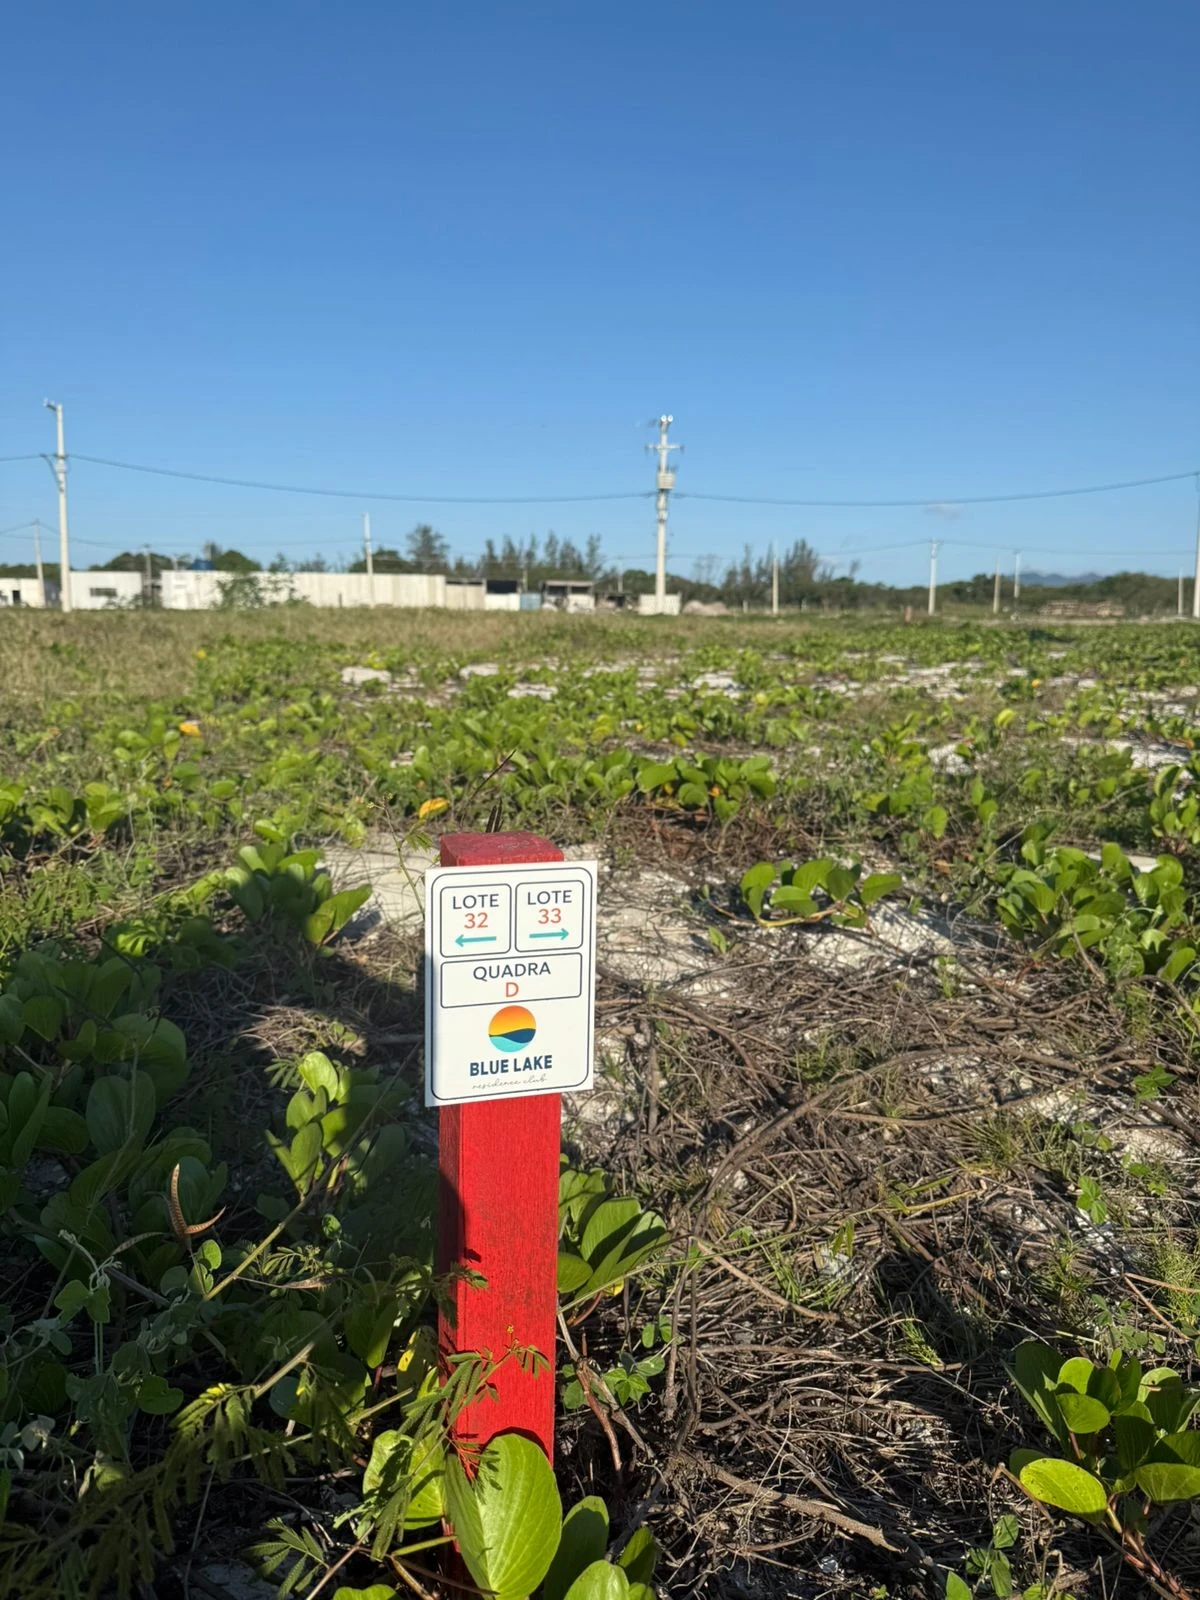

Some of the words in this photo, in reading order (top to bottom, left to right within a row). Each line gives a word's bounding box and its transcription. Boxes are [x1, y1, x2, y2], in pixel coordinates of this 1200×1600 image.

[452, 893, 500, 910] LOTE
[527, 890, 573, 906] LOTE
[464, 912, 489, 929] 32
[538, 908, 562, 925] 33
[473, 961, 551, 982] QUADRA
[505, 982, 519, 998] D
[469, 1059, 509, 1076] BLUE
[513, 1054, 553, 1073] LAKE
[472, 1077, 521, 1090] residence
[523, 1072, 546, 1084] club
